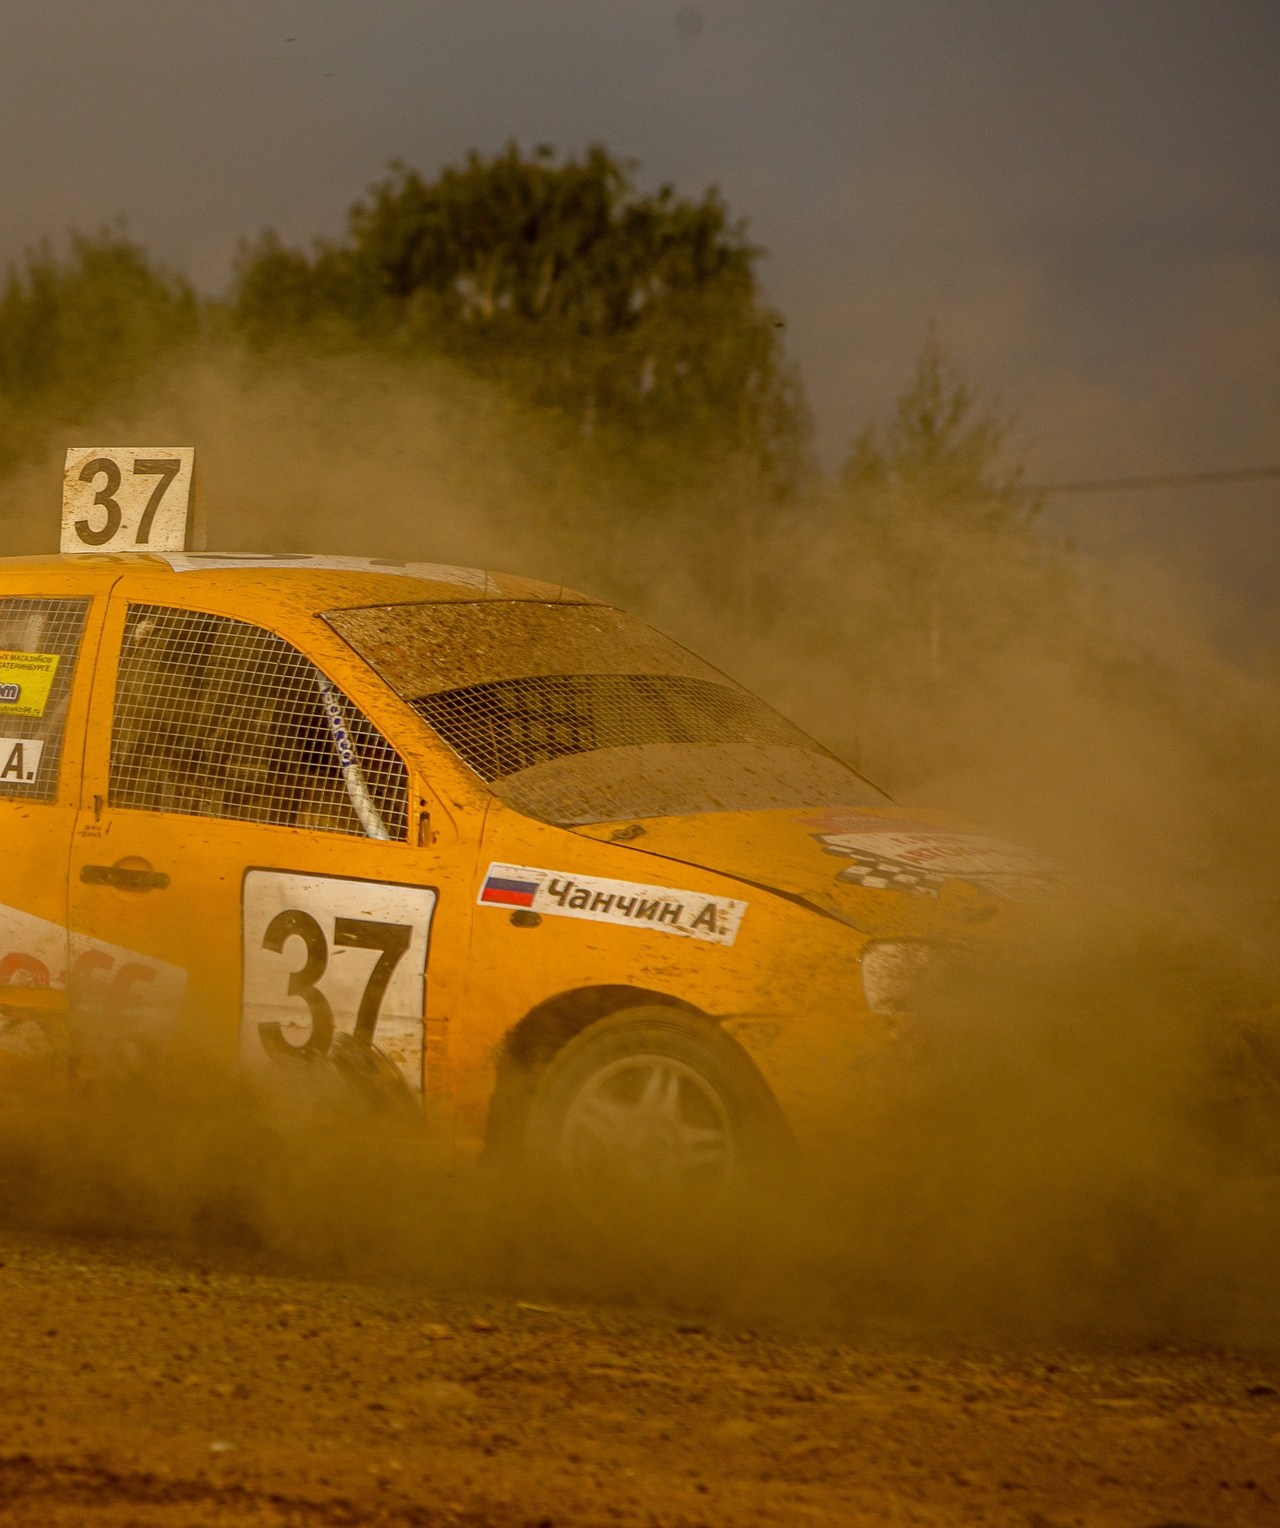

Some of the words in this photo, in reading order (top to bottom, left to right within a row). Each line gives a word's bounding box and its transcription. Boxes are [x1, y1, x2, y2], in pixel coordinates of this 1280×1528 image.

[74, 457, 182, 546] 37
[0, 743, 36, 780] А.
[547, 877, 684, 925] Чанчин
[257, 909, 413, 1061] 37
